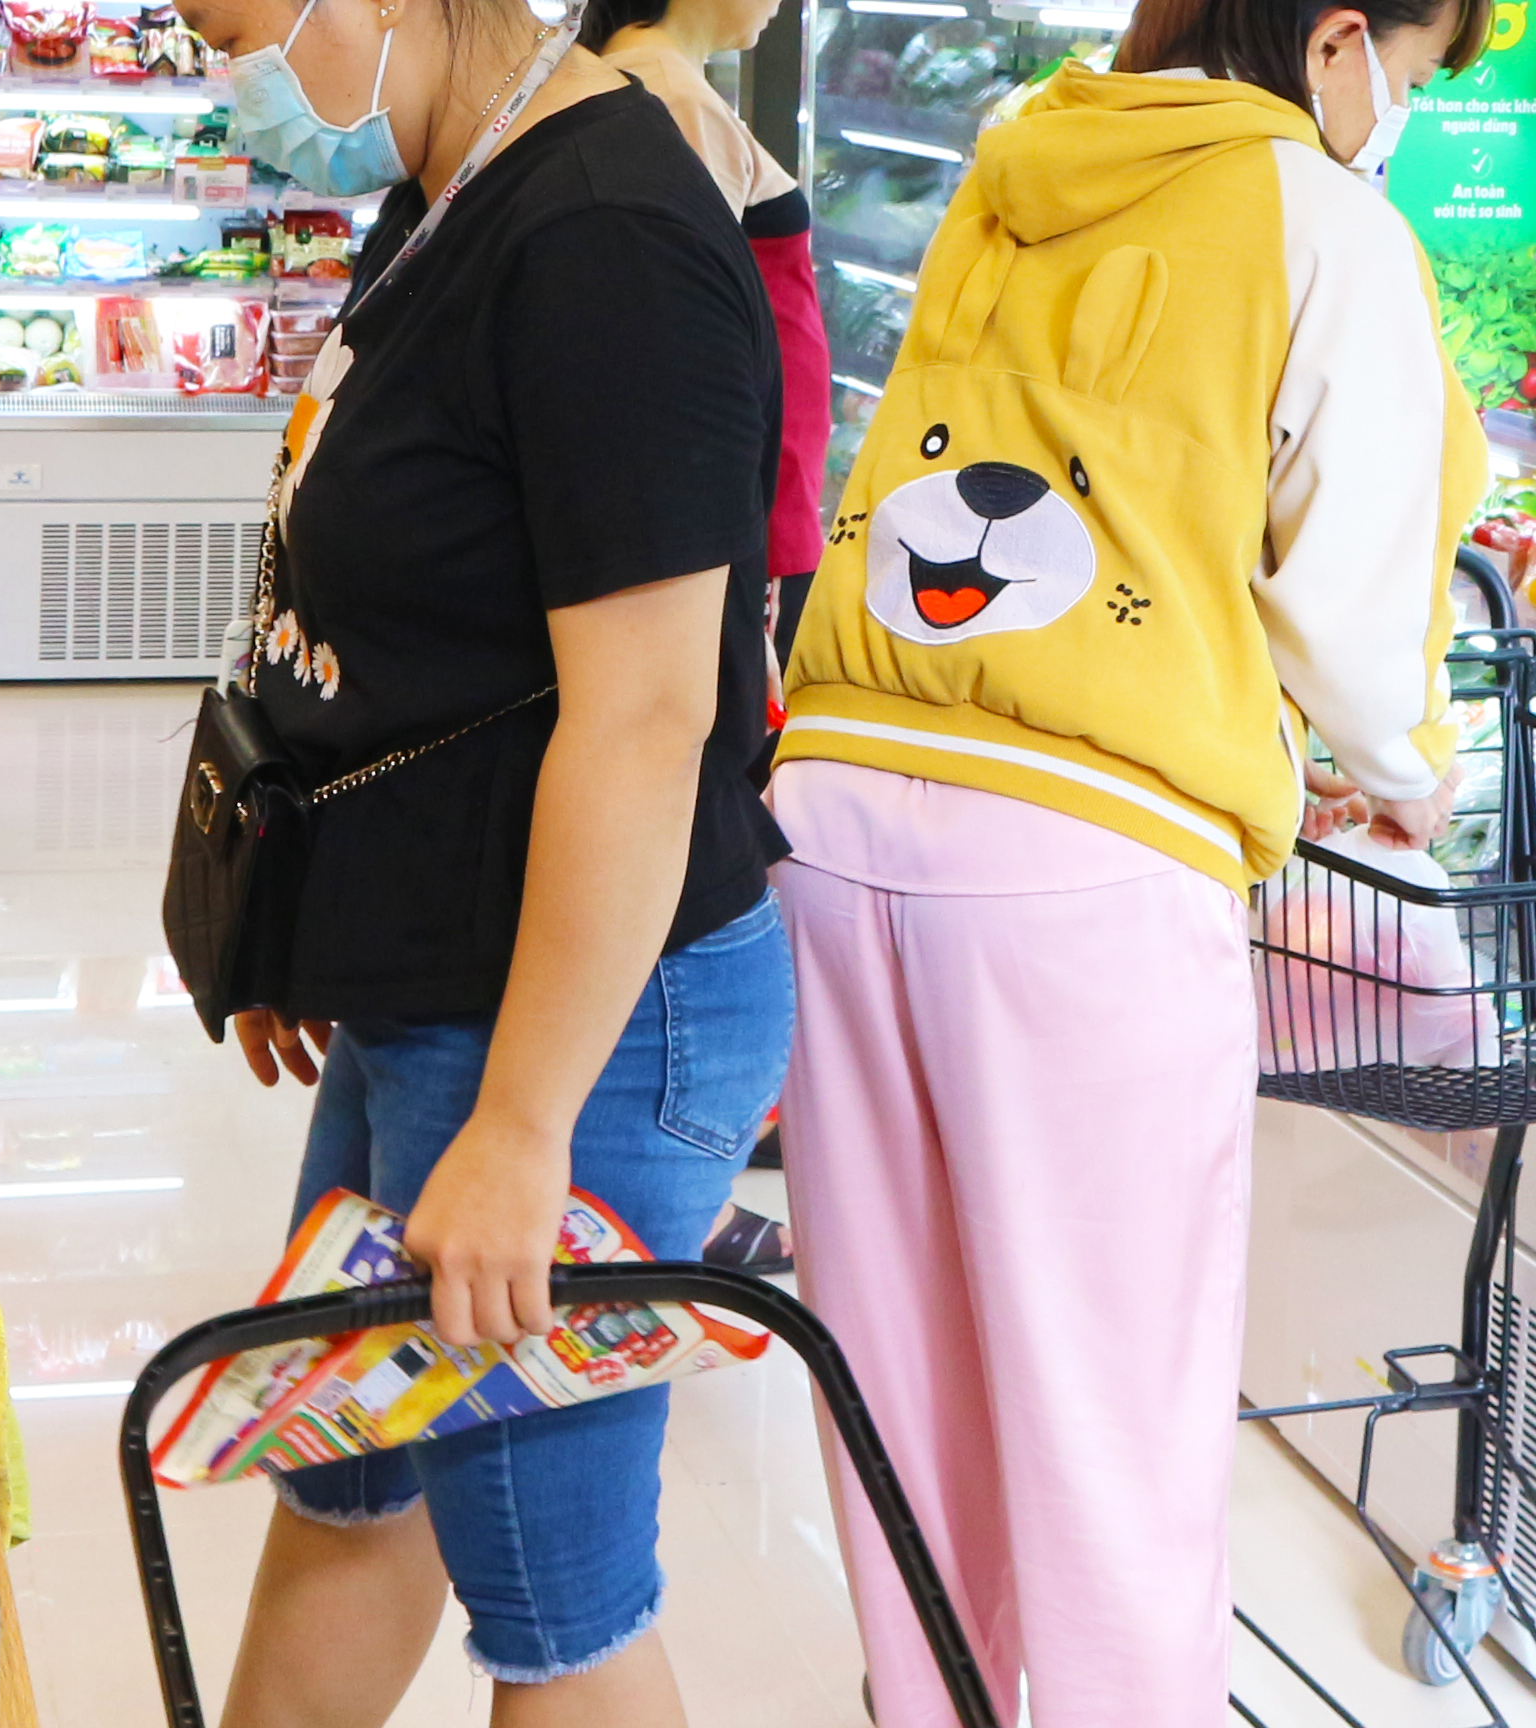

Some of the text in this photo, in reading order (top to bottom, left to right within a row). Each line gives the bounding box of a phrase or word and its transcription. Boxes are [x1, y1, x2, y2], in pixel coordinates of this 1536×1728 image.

[1488, 2, 1528, 51] ơ
[1465, 98, 1489, 113] cho
[1452, 183, 1472, 198] An
